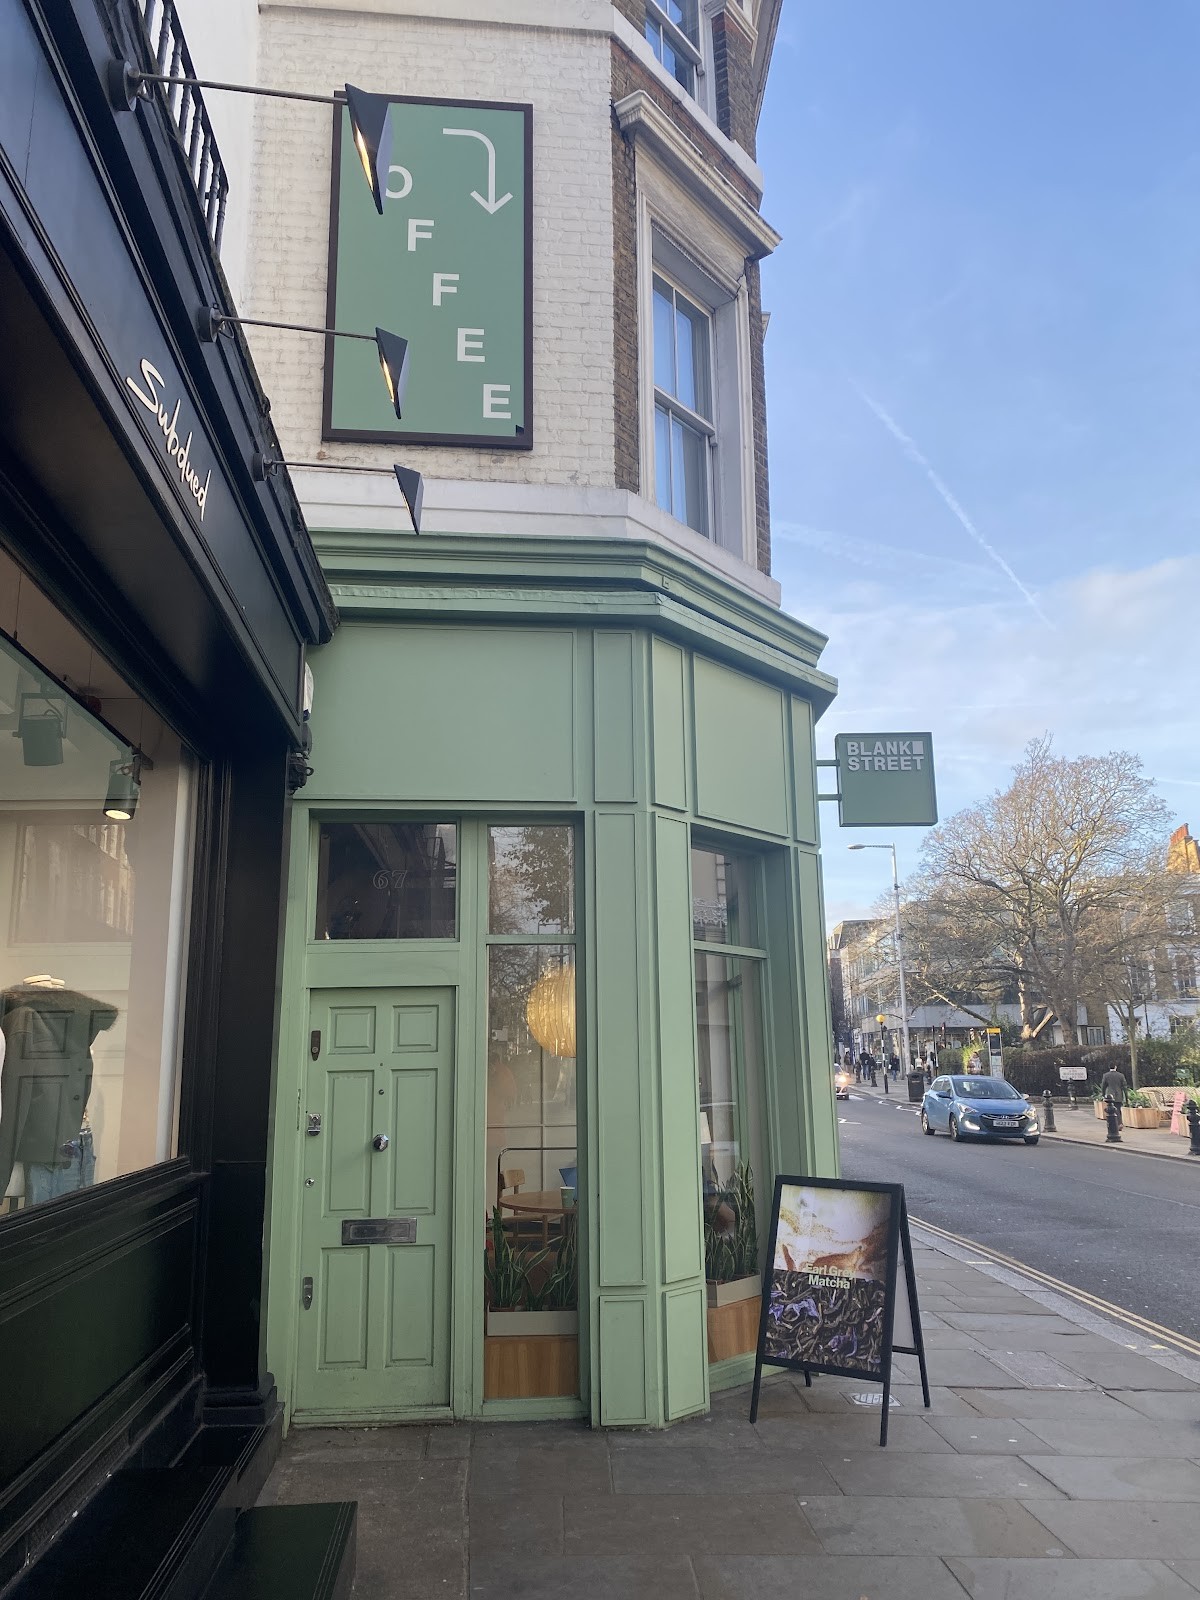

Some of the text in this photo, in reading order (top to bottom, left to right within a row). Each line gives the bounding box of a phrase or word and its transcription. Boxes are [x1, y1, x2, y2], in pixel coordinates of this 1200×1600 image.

[385, 165, 512, 419] OFFEE
[126, 358, 211, 522] Subdued
[847, 741, 911, 755] BLANK
[848, 756, 924, 770] STREET
[373, 870, 408, 889] 67
[806, 1262, 856, 1280] Earl Grey
[808, 1274, 850, 1289] Matcha
